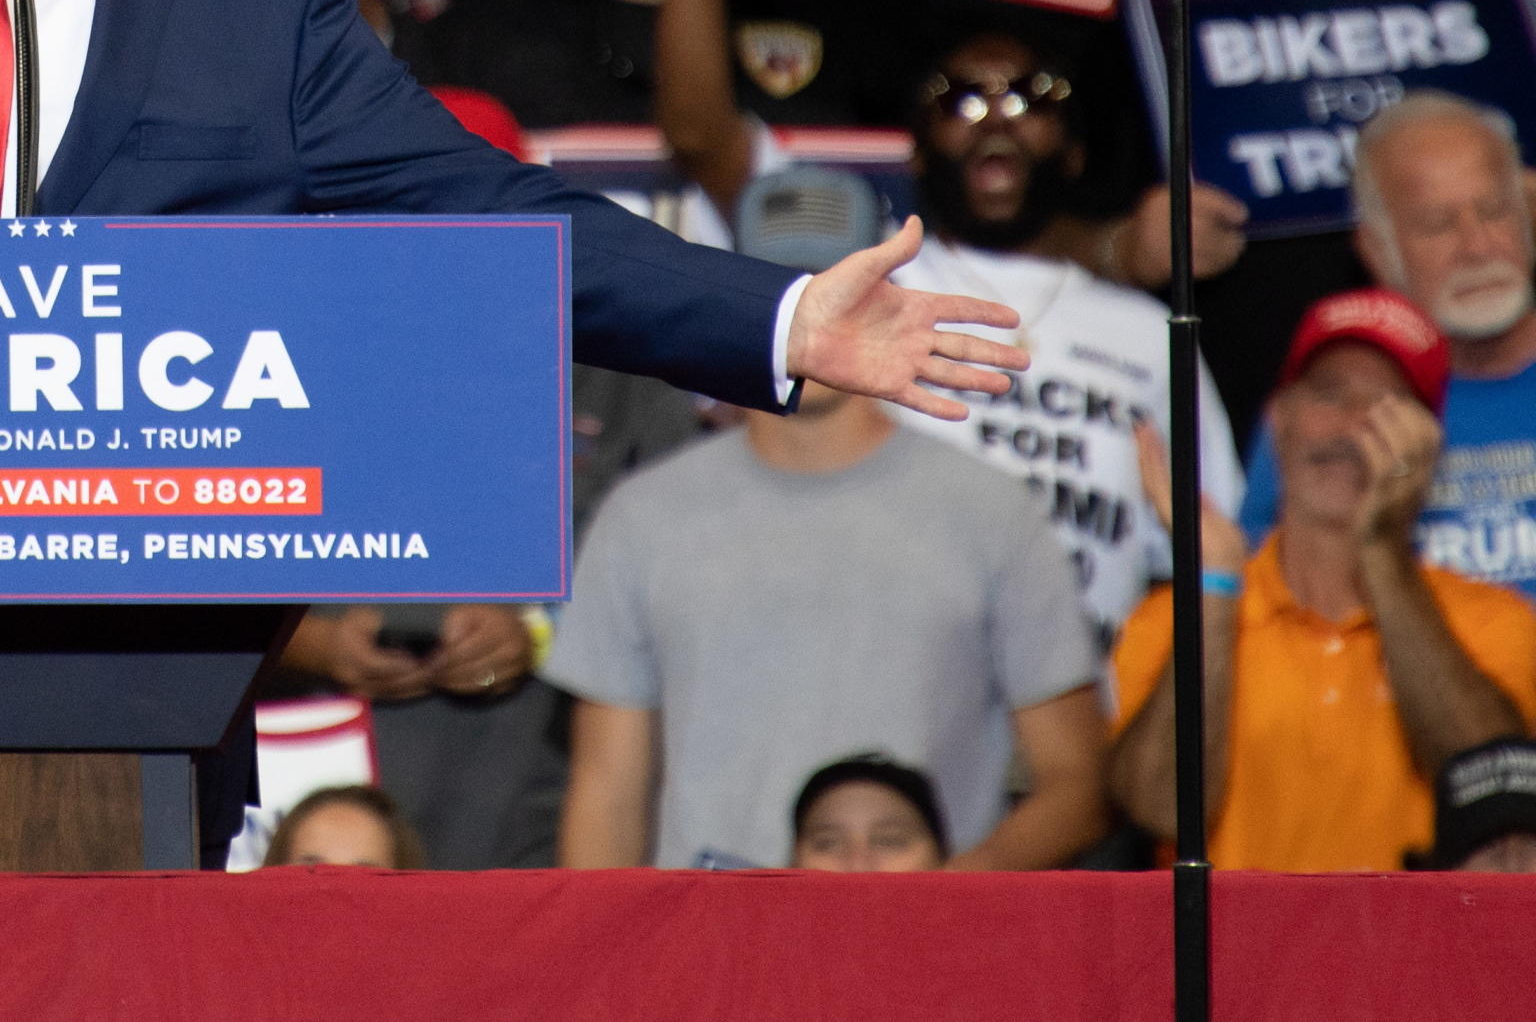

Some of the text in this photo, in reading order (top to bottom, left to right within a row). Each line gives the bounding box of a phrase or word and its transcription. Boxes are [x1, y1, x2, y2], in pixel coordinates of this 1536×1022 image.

[106, 428, 130, 450] J.
[140, 427, 243, 449] TRUMP
[132, 477, 180, 505] TO
[193, 477, 307, 504] 88022
[144, 532, 430, 560] PENNSYLVANIA
